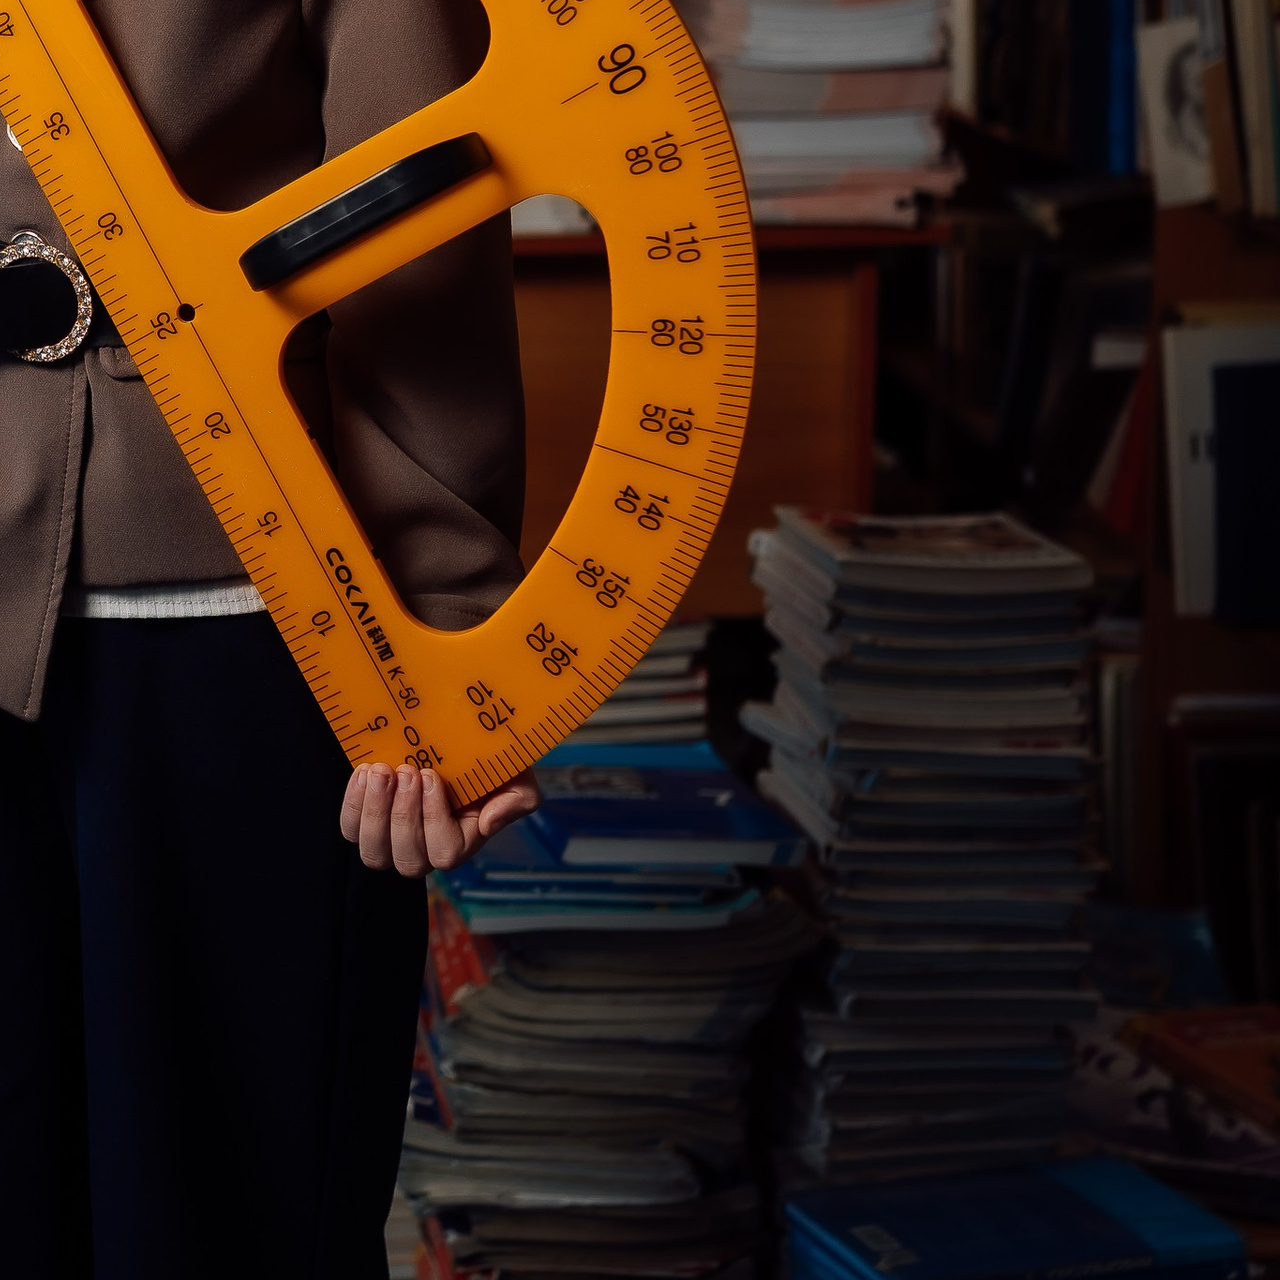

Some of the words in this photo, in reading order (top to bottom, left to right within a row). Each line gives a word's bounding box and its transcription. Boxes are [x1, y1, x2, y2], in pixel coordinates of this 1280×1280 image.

[597, 43, 647, 95] 90
[43, 111, 71, 142] 35
[624, 145, 654, 176] 80
[651, 130, 683, 173] 100
[97, 211, 124, 242] 30
[645, 230, 672, 261] 70
[672, 221, 702, 264] 110
[149, 311, 179, 340] 25
[650, 318, 676, 348] 60
[677, 314, 705, 356] 120
[204, 411, 232, 440] 20
[639, 403, 667, 433] 50
[666, 405, 694, 446] 130
[614, 484, 642, 514] 40
[637, 493, 671, 532] 140
[256, 511, 283, 538] 15
[575, 557, 606, 589] 30
[595, 571, 632, 610] 150
[311, 610, 337, 638] 10
[525, 621, 556, 655] 20
[541, 639, 580, 677] 160
[387, 665, 421, 710] K-50
[465, 677, 495, 707] 10
[366, 715, 389, 732] 5
[477, 696, 517, 733] 170
[403, 725, 421, 747] 0
